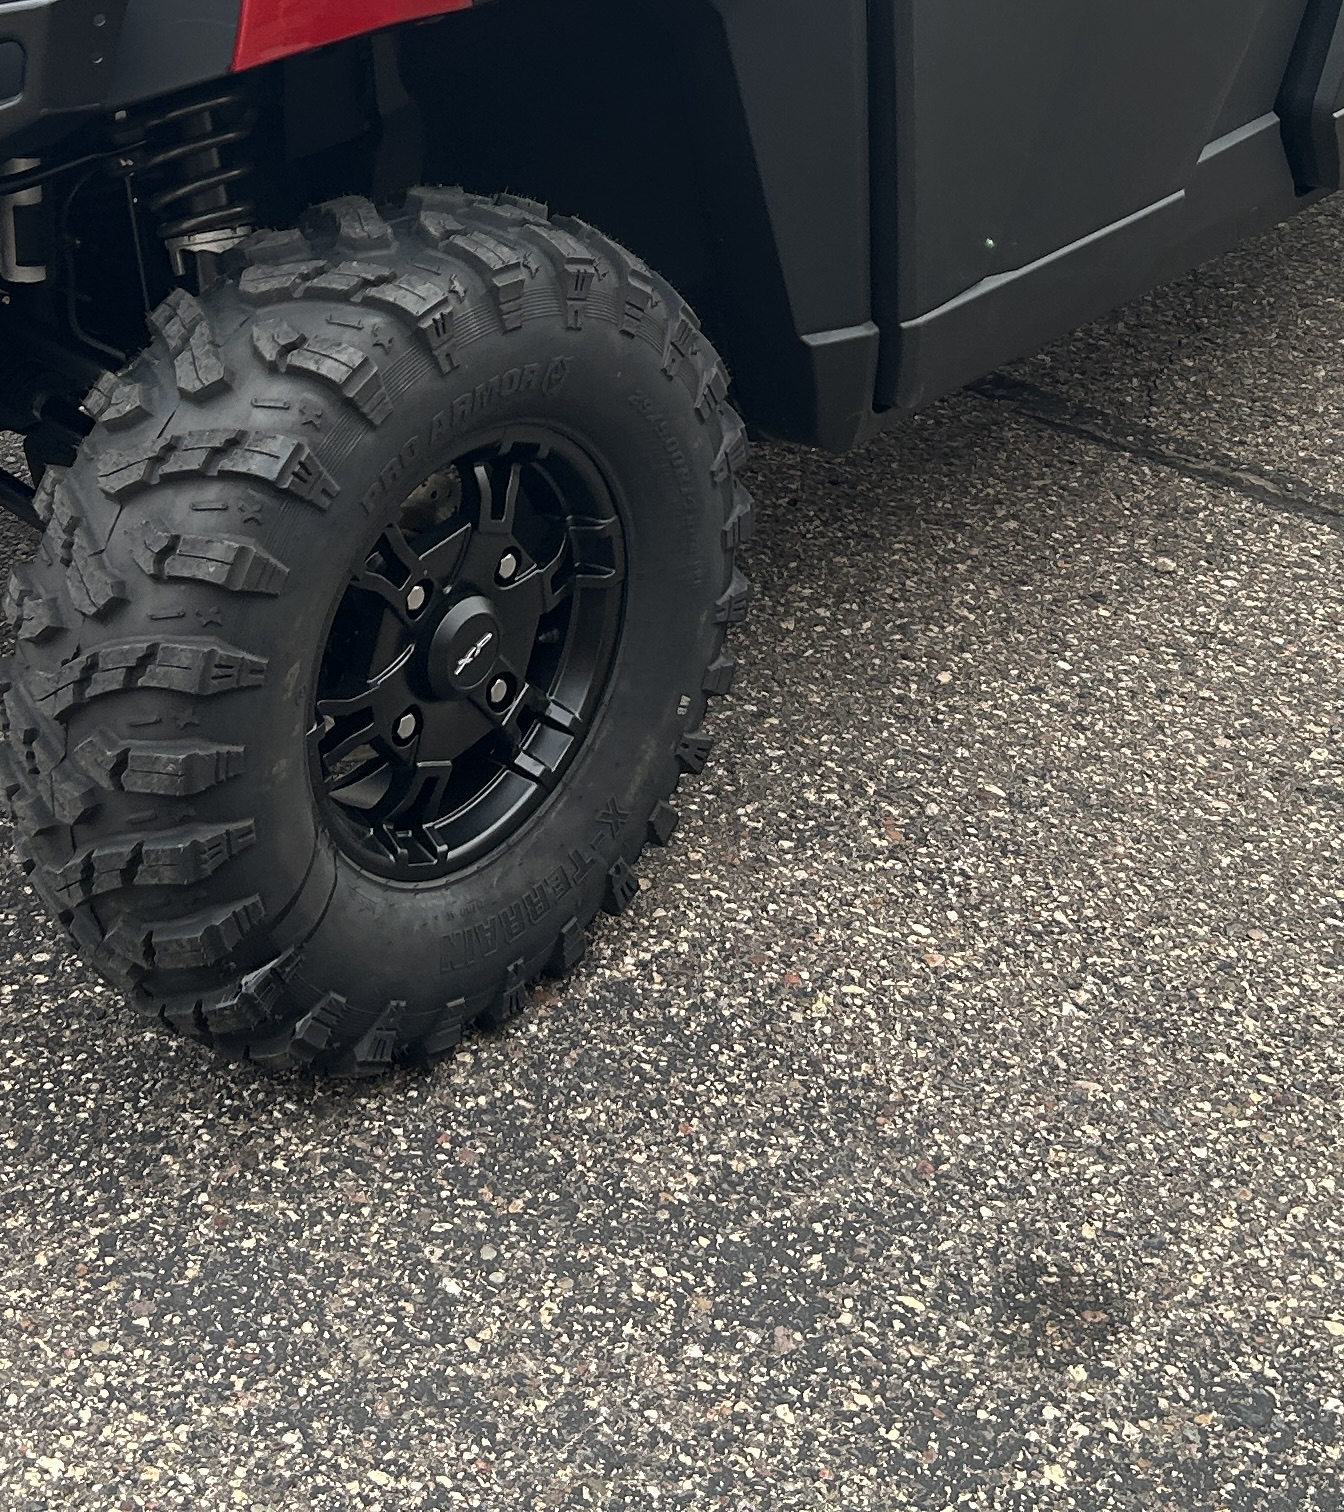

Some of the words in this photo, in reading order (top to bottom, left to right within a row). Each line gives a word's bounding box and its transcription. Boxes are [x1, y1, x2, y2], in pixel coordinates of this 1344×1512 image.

[360, 435, 420, 517] PRO
[428, 362, 540, 446] ARMOR
[439, 796, 632, 974] X-TERRAIN
